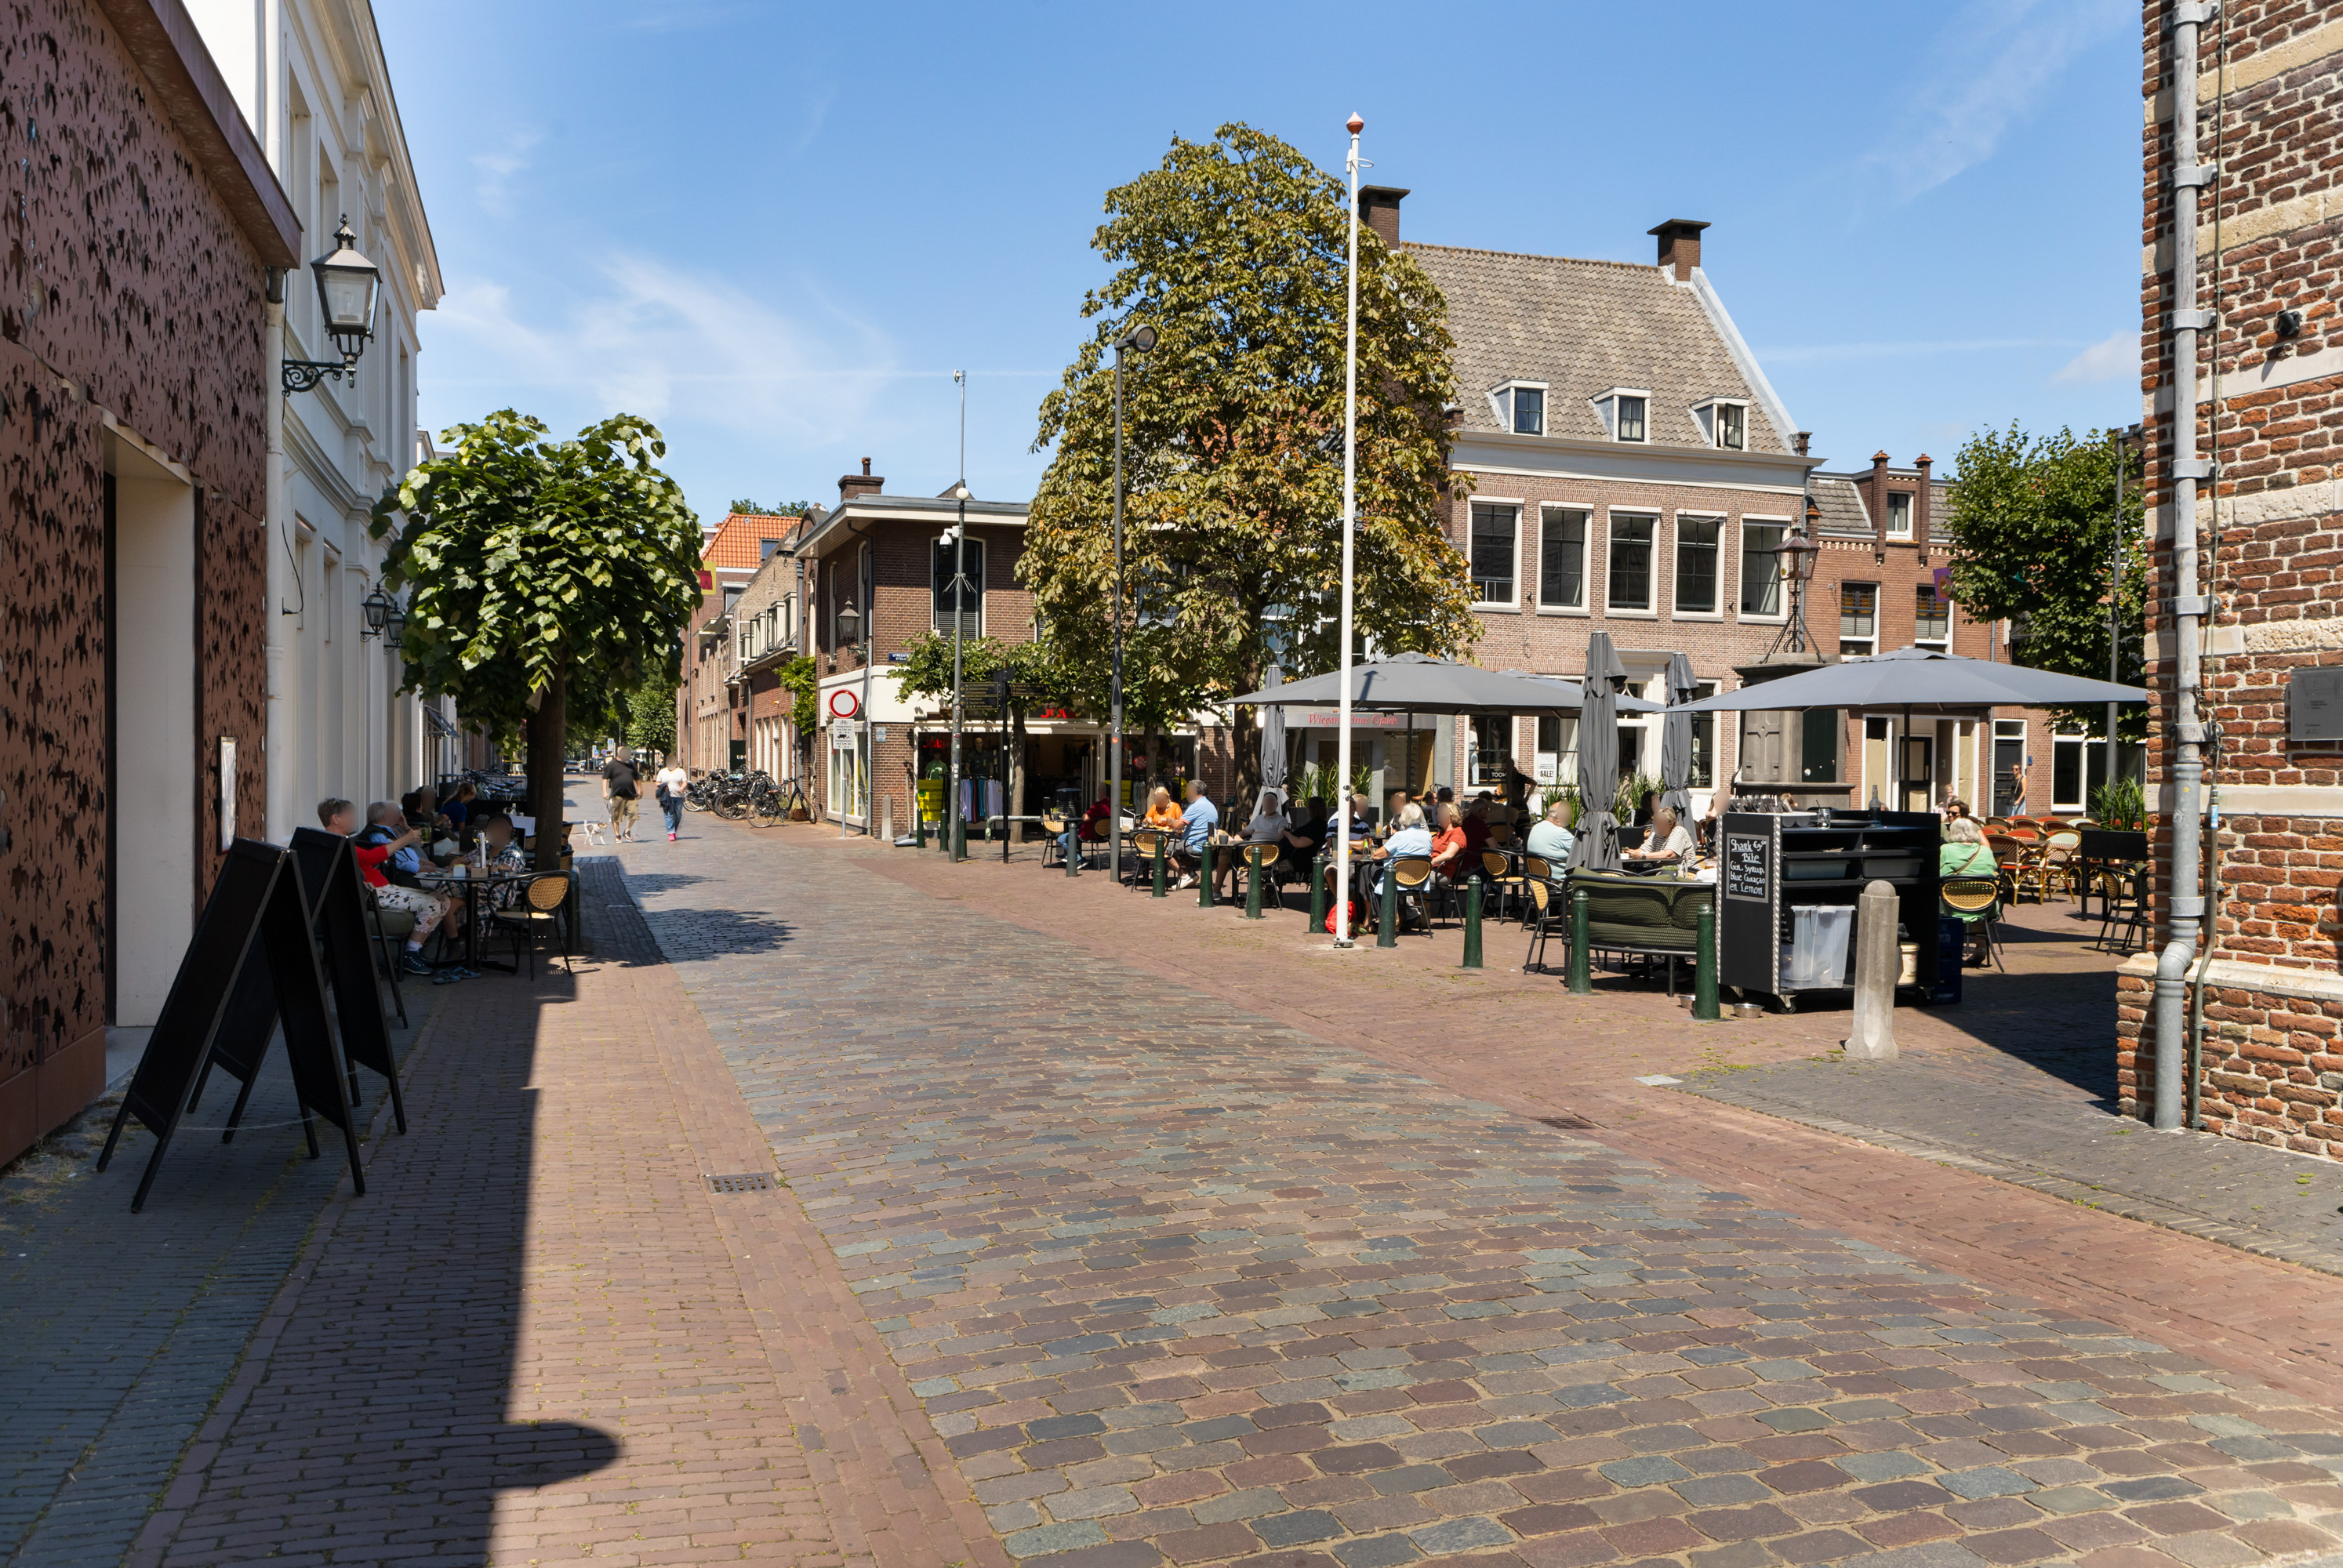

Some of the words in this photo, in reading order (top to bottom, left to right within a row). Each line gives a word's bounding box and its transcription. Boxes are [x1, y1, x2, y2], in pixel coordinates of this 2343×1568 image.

[1309, 714, 1340, 727] Wiegan
[1731, 839, 1753, 851] Shark
[1742, 852, 1760, 862] Bite
[1730, 871, 1742, 880] blue
[1730, 883, 1738, 891] en
[1741, 882, 1763, 895] Lemon
